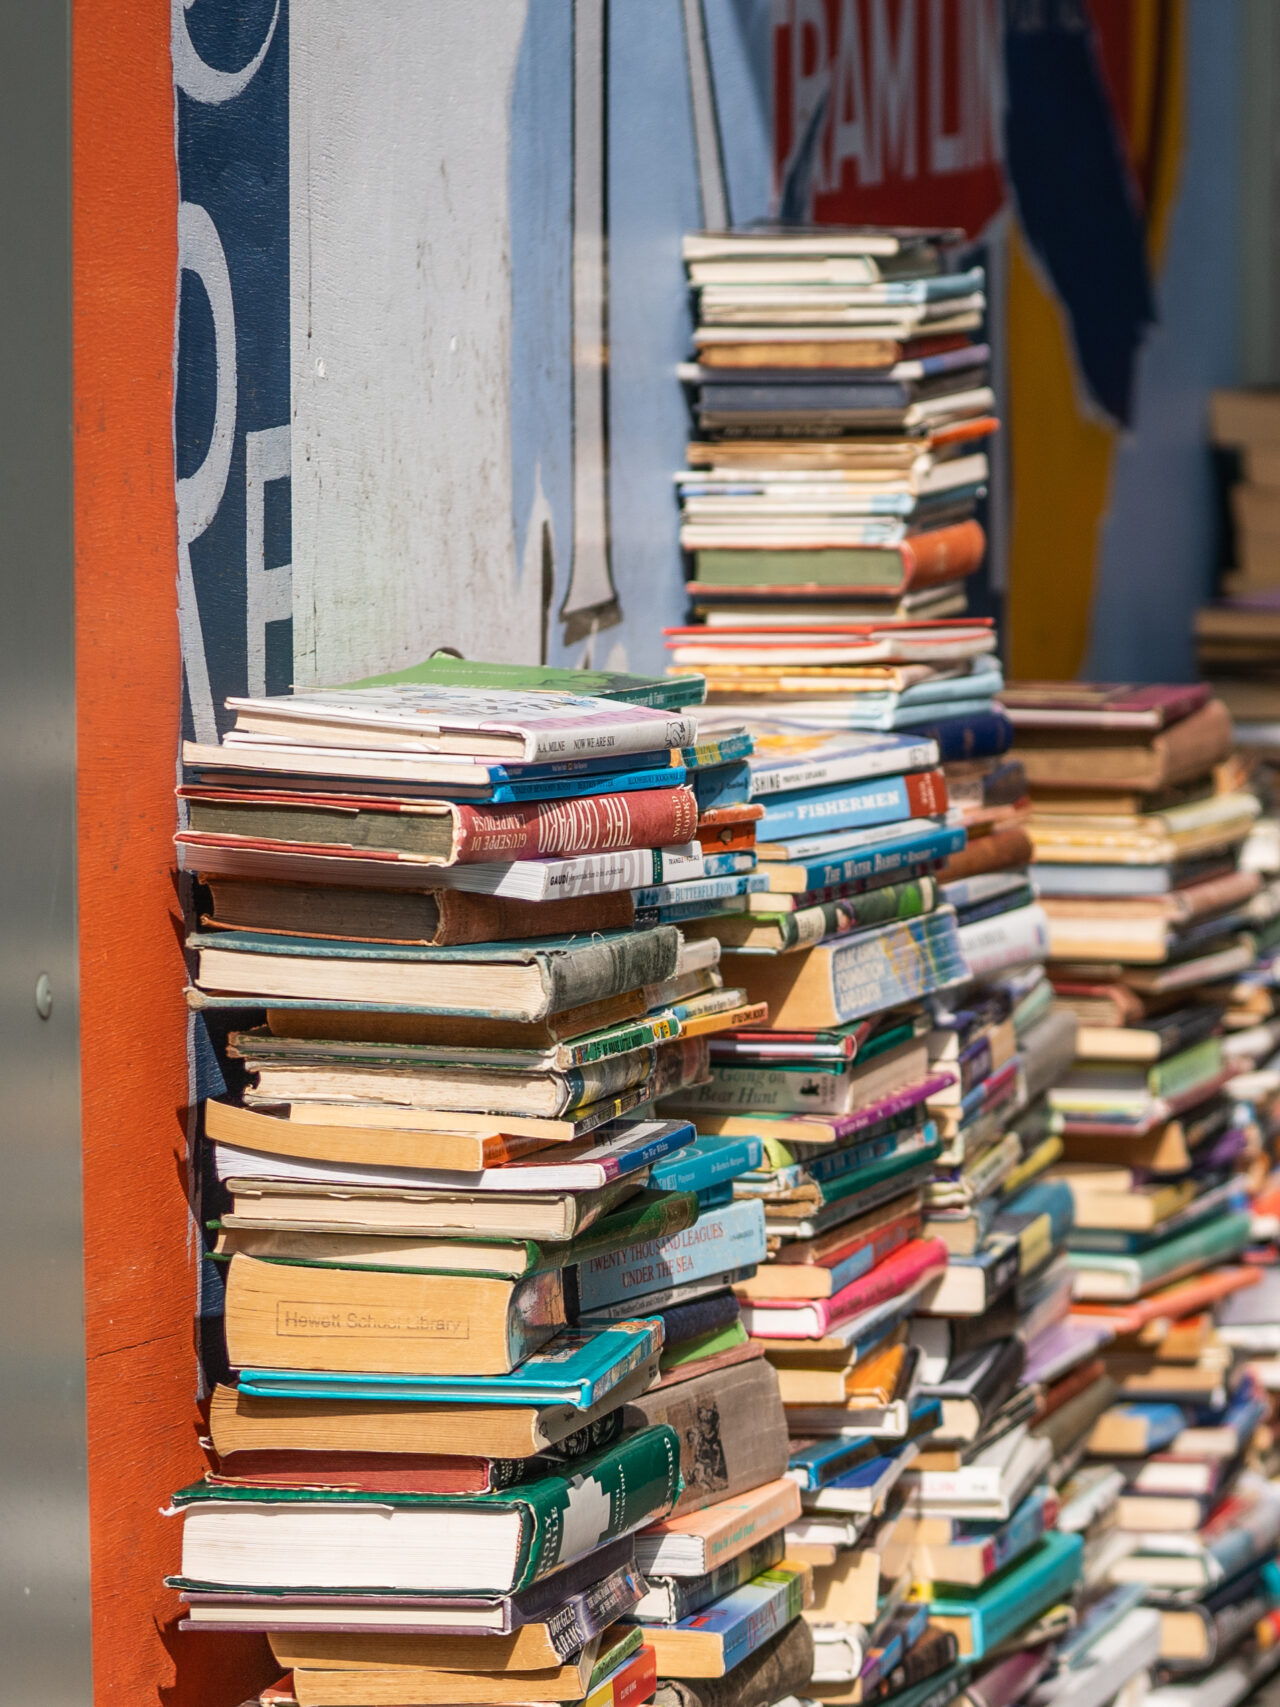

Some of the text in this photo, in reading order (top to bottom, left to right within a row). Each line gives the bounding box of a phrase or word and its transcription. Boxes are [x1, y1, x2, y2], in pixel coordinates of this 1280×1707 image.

[549, 740, 566, 752] MILNE
[573, 738, 586, 749] NOW
[672, 795, 682, 838] WORLD
[796, 789, 900, 820] FISHERMEN
[472, 813, 527, 832] LAMPEDUSA
[537, 797, 633, 852] THE LEOPARD
[471, 833, 527, 851] GIUSEPPE DI
[824, 865, 841, 884] THE
[844, 859, 872, 878] WATER
[675, 884, 714, 901] BUTTERFLY
[700, 1086, 735, 1103] Bear
[738, 1086, 778, 1104] Hunt
[589, 1222, 724, 1273] TWENTY THOUSAND LEAGUES
[621, 1256, 694, 1289] UNDER THE SEA
[347, 1312, 401, 1329] School
[405, 1315, 462, 1334] Library
[664, 1437, 674, 1504] XFORD
[538, 1516, 552, 1574] HOLY
[546, 1506, 559, 1572] BIBLE
[548, 1603, 577, 1637] DOUGLAS
[555, 1622, 585, 1656] ADAMS
